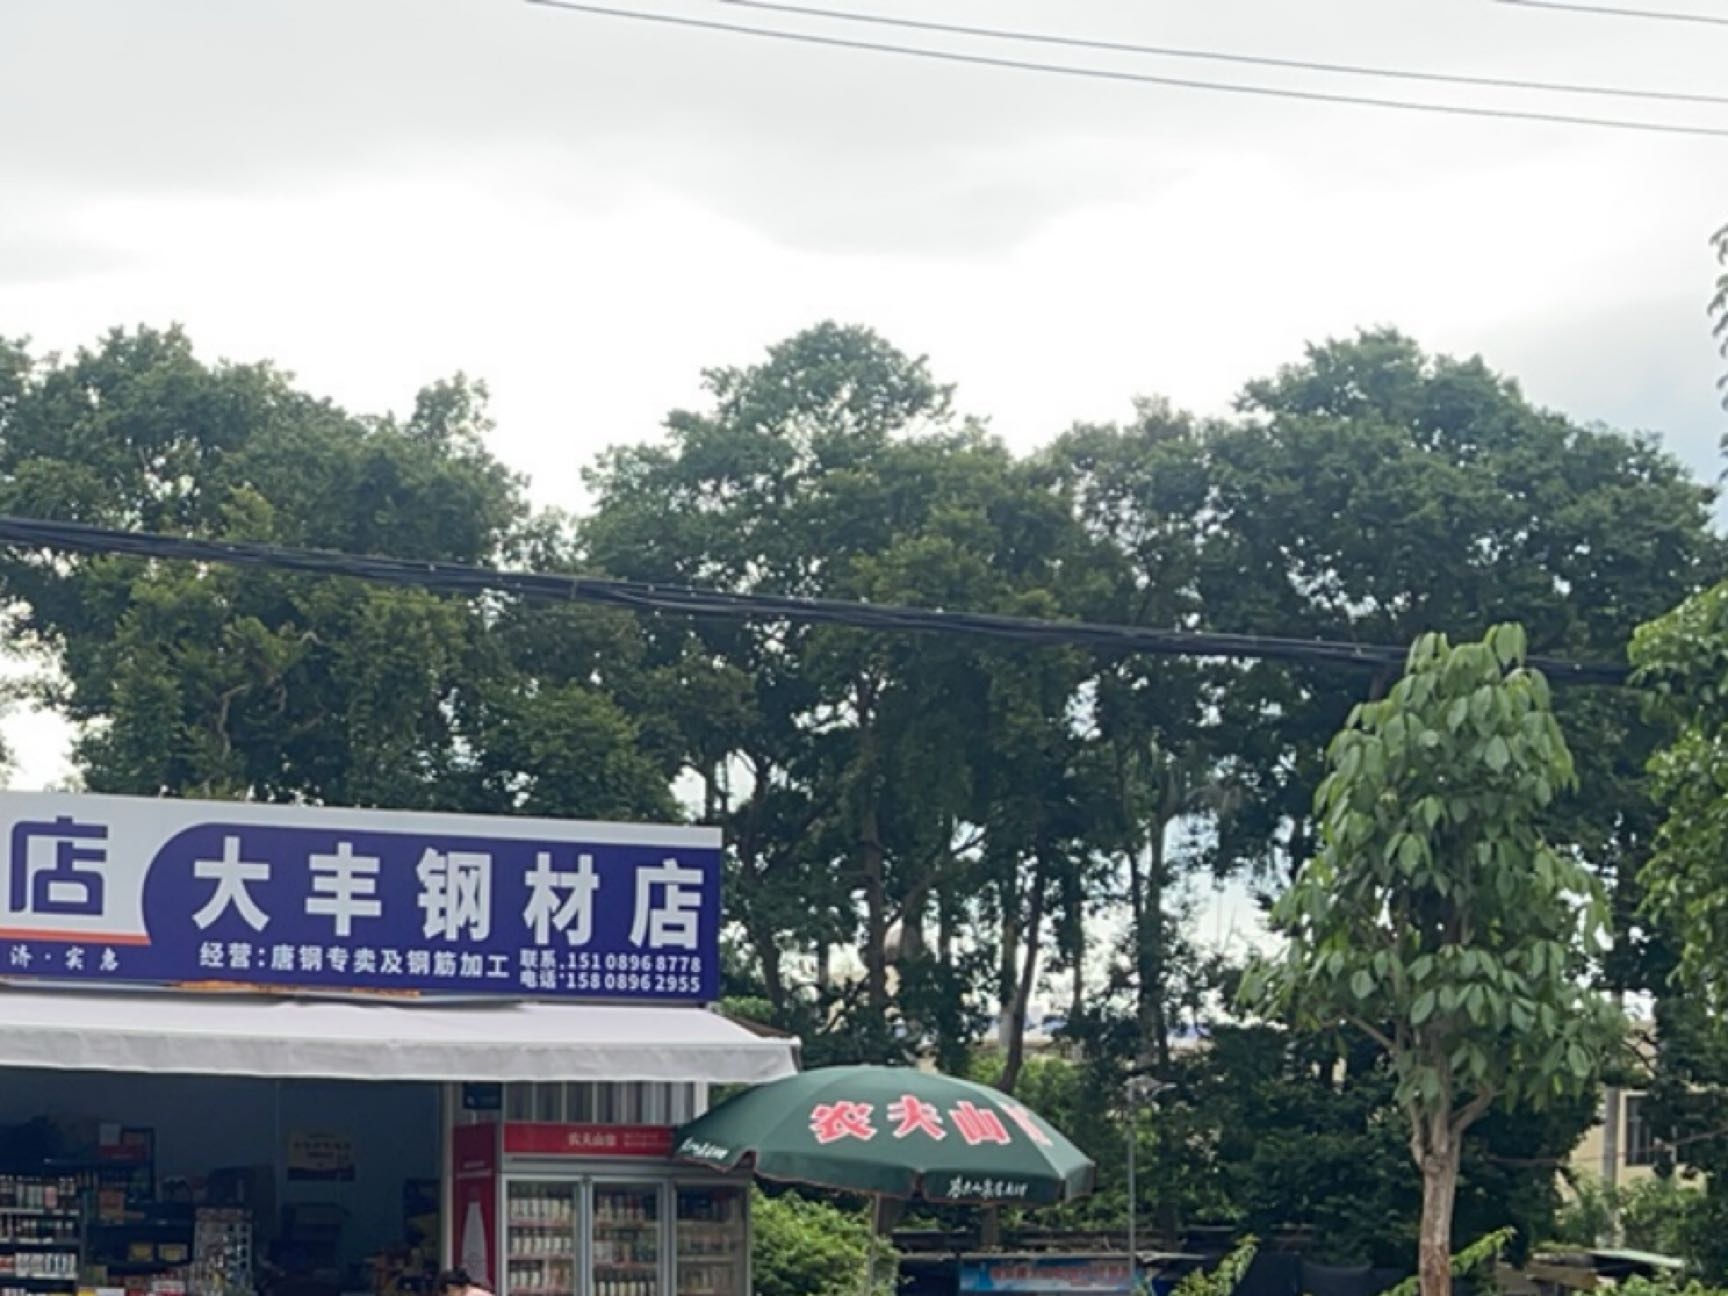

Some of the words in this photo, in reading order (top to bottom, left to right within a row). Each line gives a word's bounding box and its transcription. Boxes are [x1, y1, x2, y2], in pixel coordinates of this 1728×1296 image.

[191, 834, 706, 952] 大丰钢材店
